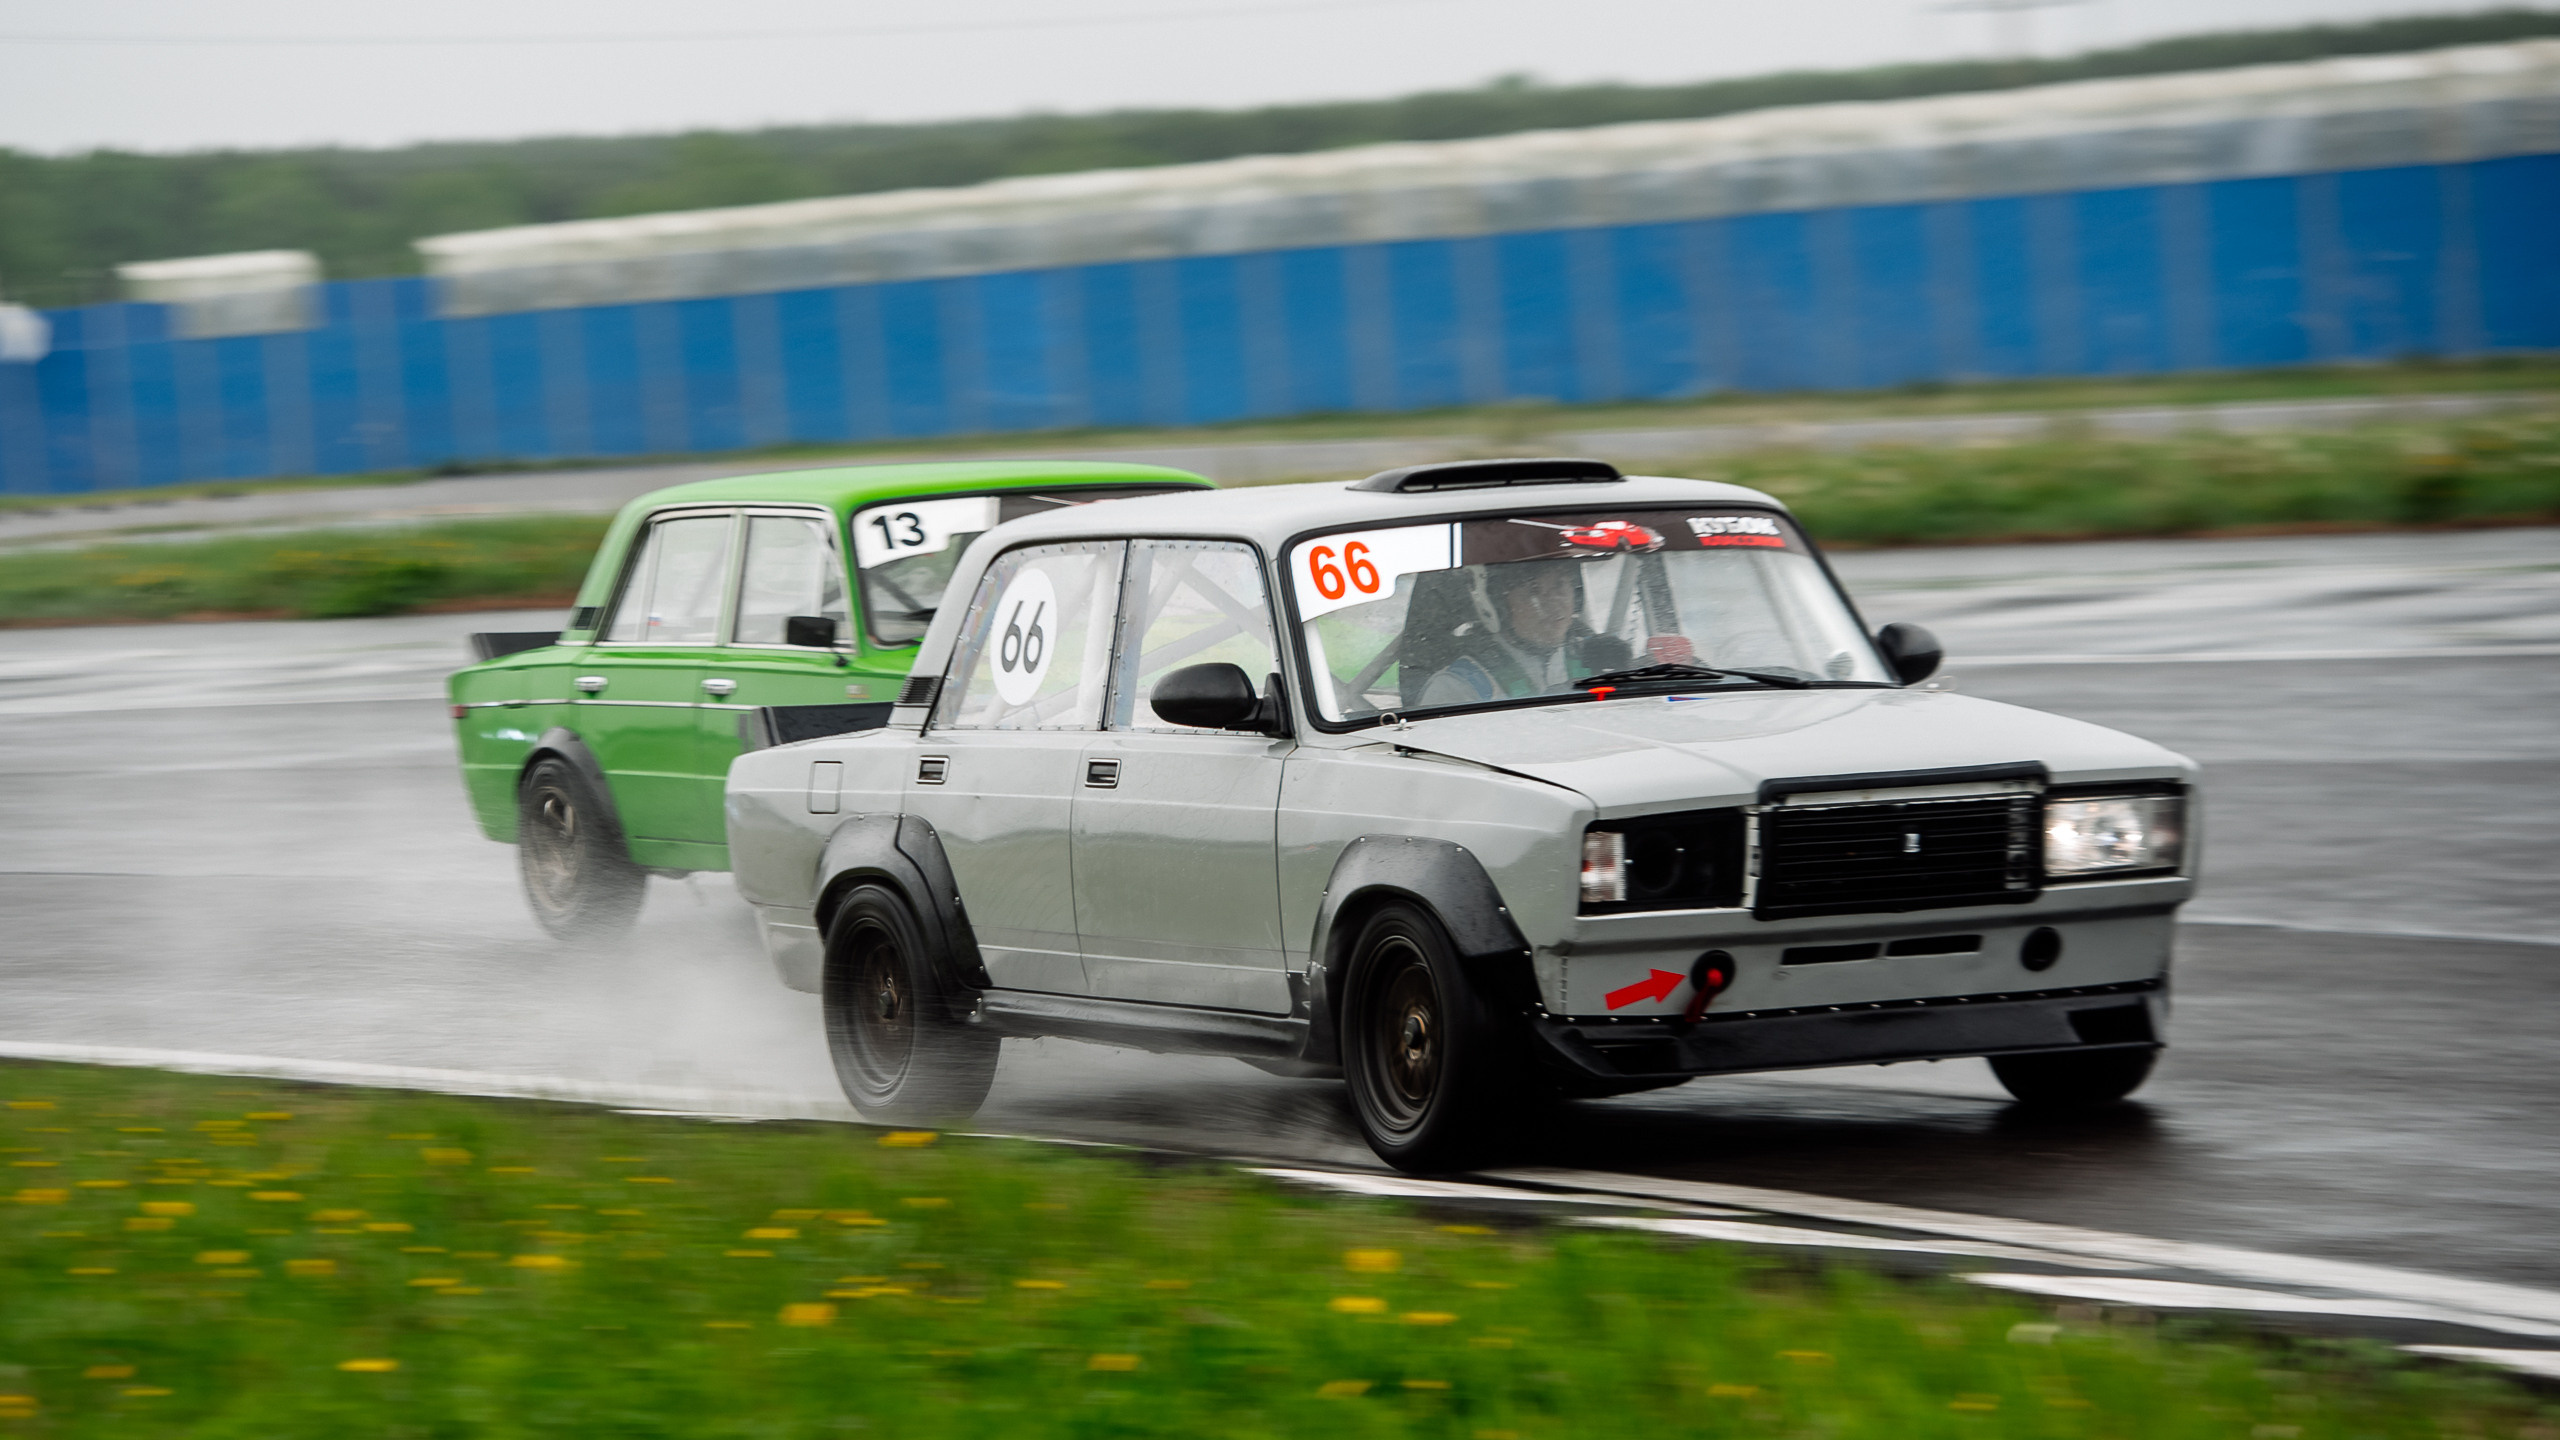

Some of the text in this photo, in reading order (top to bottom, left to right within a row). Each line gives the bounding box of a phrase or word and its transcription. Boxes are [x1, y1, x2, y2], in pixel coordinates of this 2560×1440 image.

[872, 512, 925, 549] 13
[1309, 541, 1380, 600] 66
[1001, 600, 1045, 674] 66
